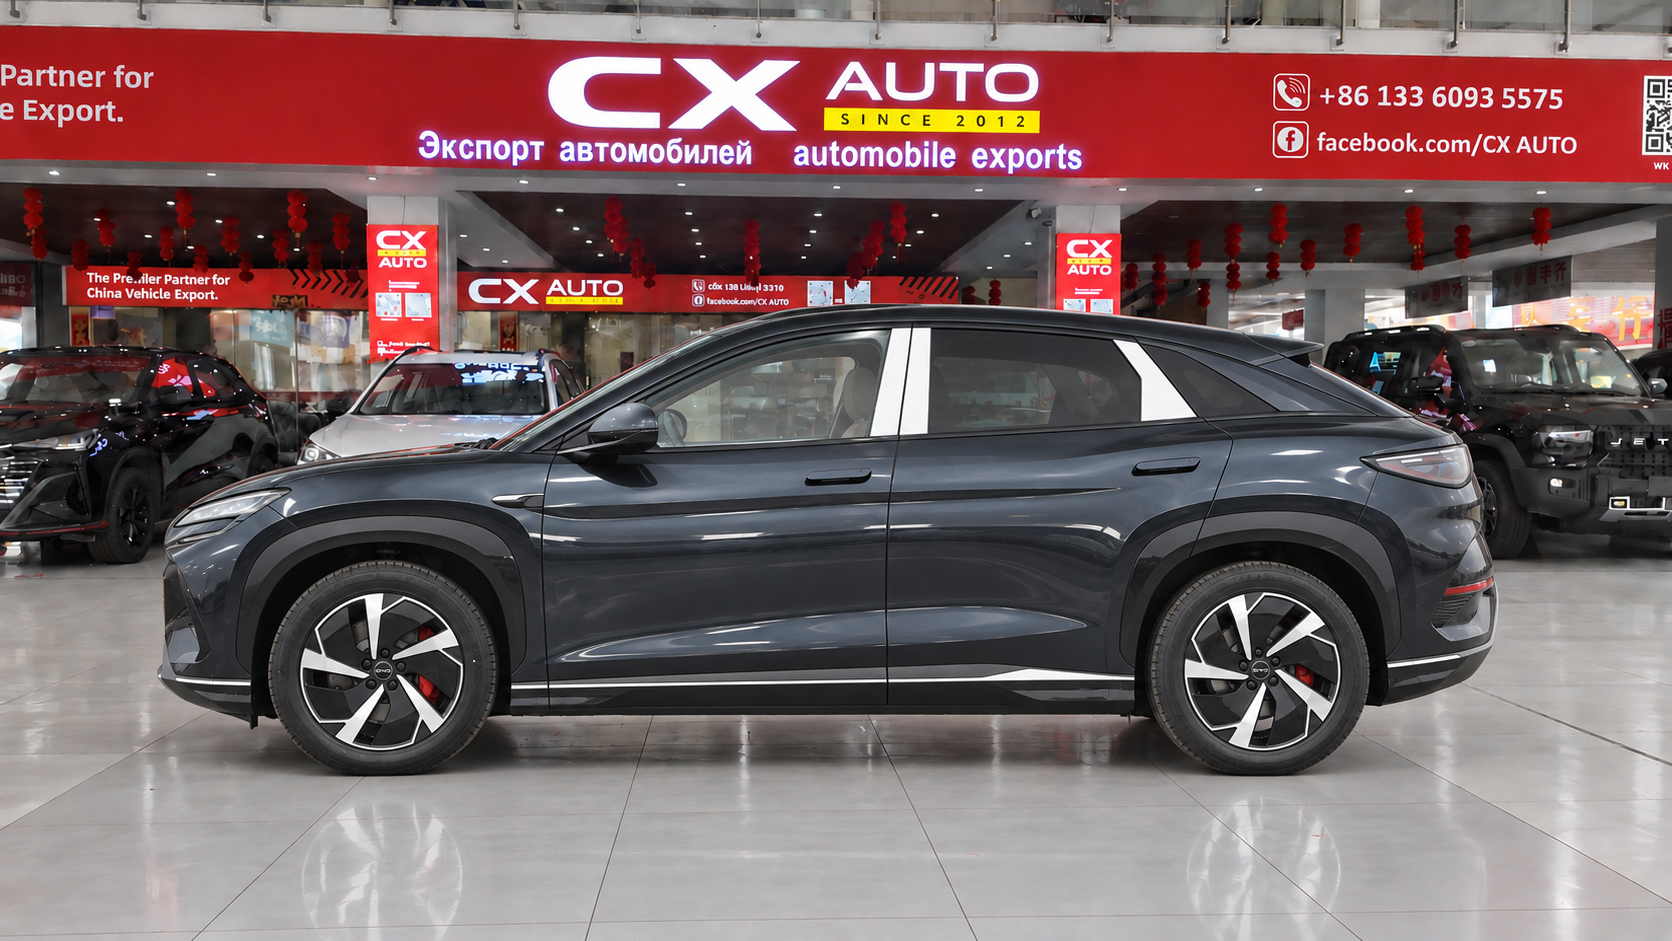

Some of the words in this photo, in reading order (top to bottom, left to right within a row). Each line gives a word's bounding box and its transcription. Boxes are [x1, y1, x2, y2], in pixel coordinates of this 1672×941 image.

[0, 64, 106, 88] Partner
[114, 64, 155, 89] for
[826, 62, 1040, 103] AUTO
[548, 56, 801, 132] CX
[1320, 84, 1369, 107] +86
[1377, 85, 1424, 108] 133
[1432, 86, 1494, 109] 6093
[1501, 87, 1563, 110] 5575
[23, 99, 124, 128] Export.
[840, 112, 932, 127] SINCE
[956, 114, 1028, 129] 2012
[418, 130, 545, 166] Экспорт
[559, 136, 753, 166] автомобилей
[1316, 131, 1511, 157] facebook.com/CX
[1515, 135, 1578, 155] AUTO
[793, 139, 957, 169] automobile
[971, 142, 1083, 174] exports
[376, 230, 427, 250] CX
[1066, 239, 1113, 258] CX
[378, 257, 428, 268] AUTO
[1067, 264, 1112, 275] AUTO
[86, 272, 110, 284] The
[164, 274, 210, 286] Partner
[212, 274, 231, 286] for
[546, 279, 624, 297] AUTO
[86, 287, 122, 299] China
[125, 288, 171, 300] Vehicle
[174, 288, 219, 303] Export.
[468, 278, 540, 305] CX
[768, 298, 790, 306] AUTO
